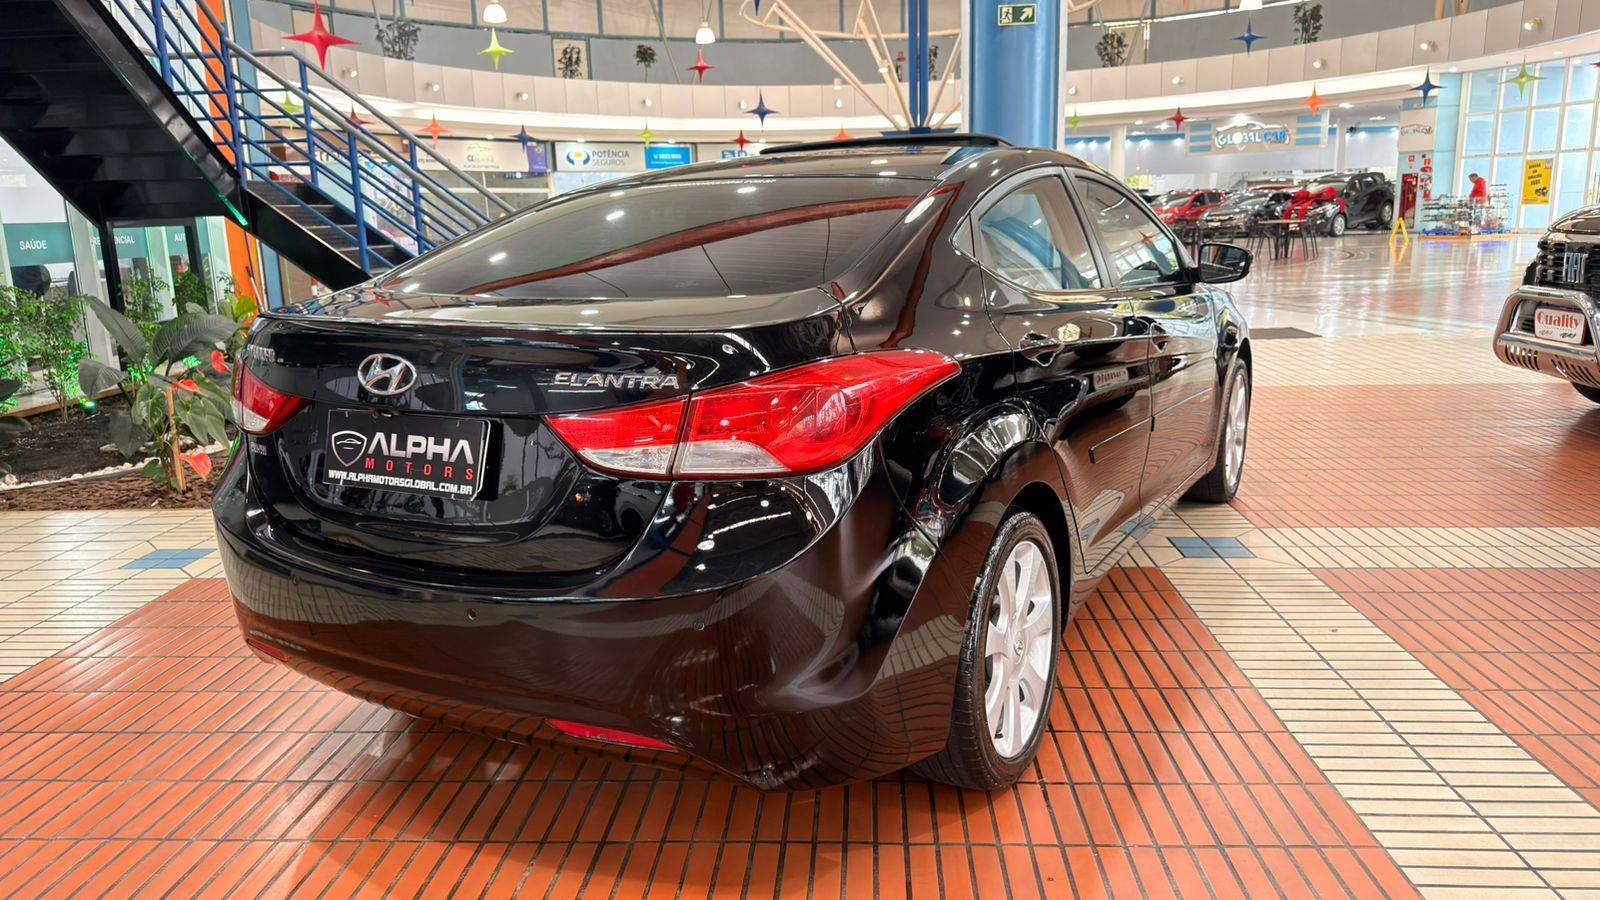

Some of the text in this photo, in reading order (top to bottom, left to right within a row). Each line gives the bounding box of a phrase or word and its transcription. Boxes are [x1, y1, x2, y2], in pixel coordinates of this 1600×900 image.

[592, 149, 629, 159] POTÊNCIA
[19, 239, 47, 250] SAÚDE
[1537, 311, 1579, 329] Quality
[554, 371, 680, 389] ELANTRA
[367, 431, 474, 465] ALPHA
[365, 457, 474, 480] MOTORS
[328, 469, 473, 495] WWW.ALPHAMOTORSGLOBAL.COM.BR
